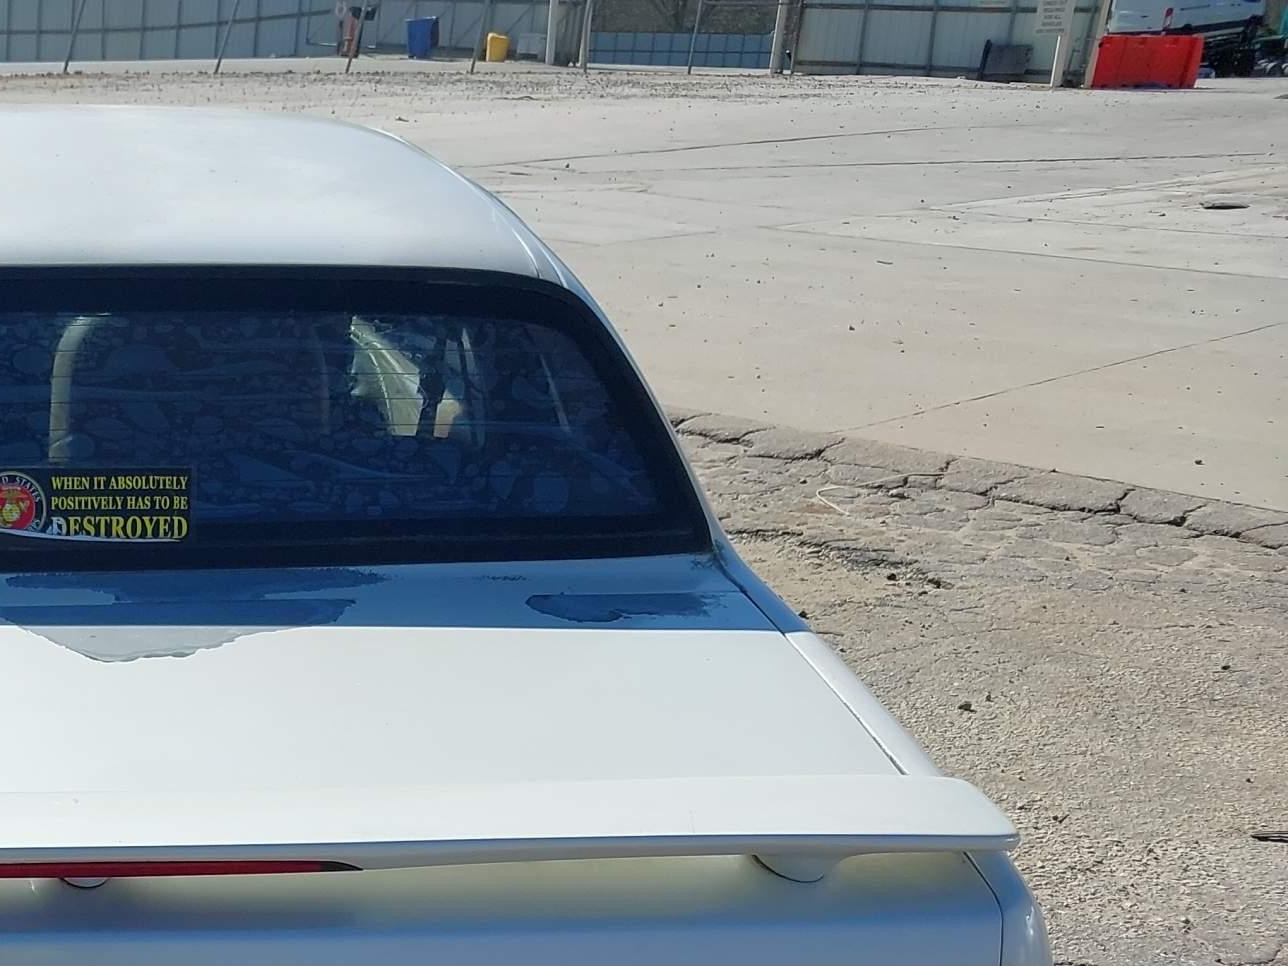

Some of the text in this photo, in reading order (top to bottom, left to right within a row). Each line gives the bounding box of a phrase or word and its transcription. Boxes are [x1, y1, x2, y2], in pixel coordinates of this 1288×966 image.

[15, 476, 41, 503] STATES
[51, 476, 188, 490] WHEN IT ABSOLUTELY
[51, 496, 188, 510] POSITIVELY HAS TO BE
[51, 516, 188, 539] DESTROYED
